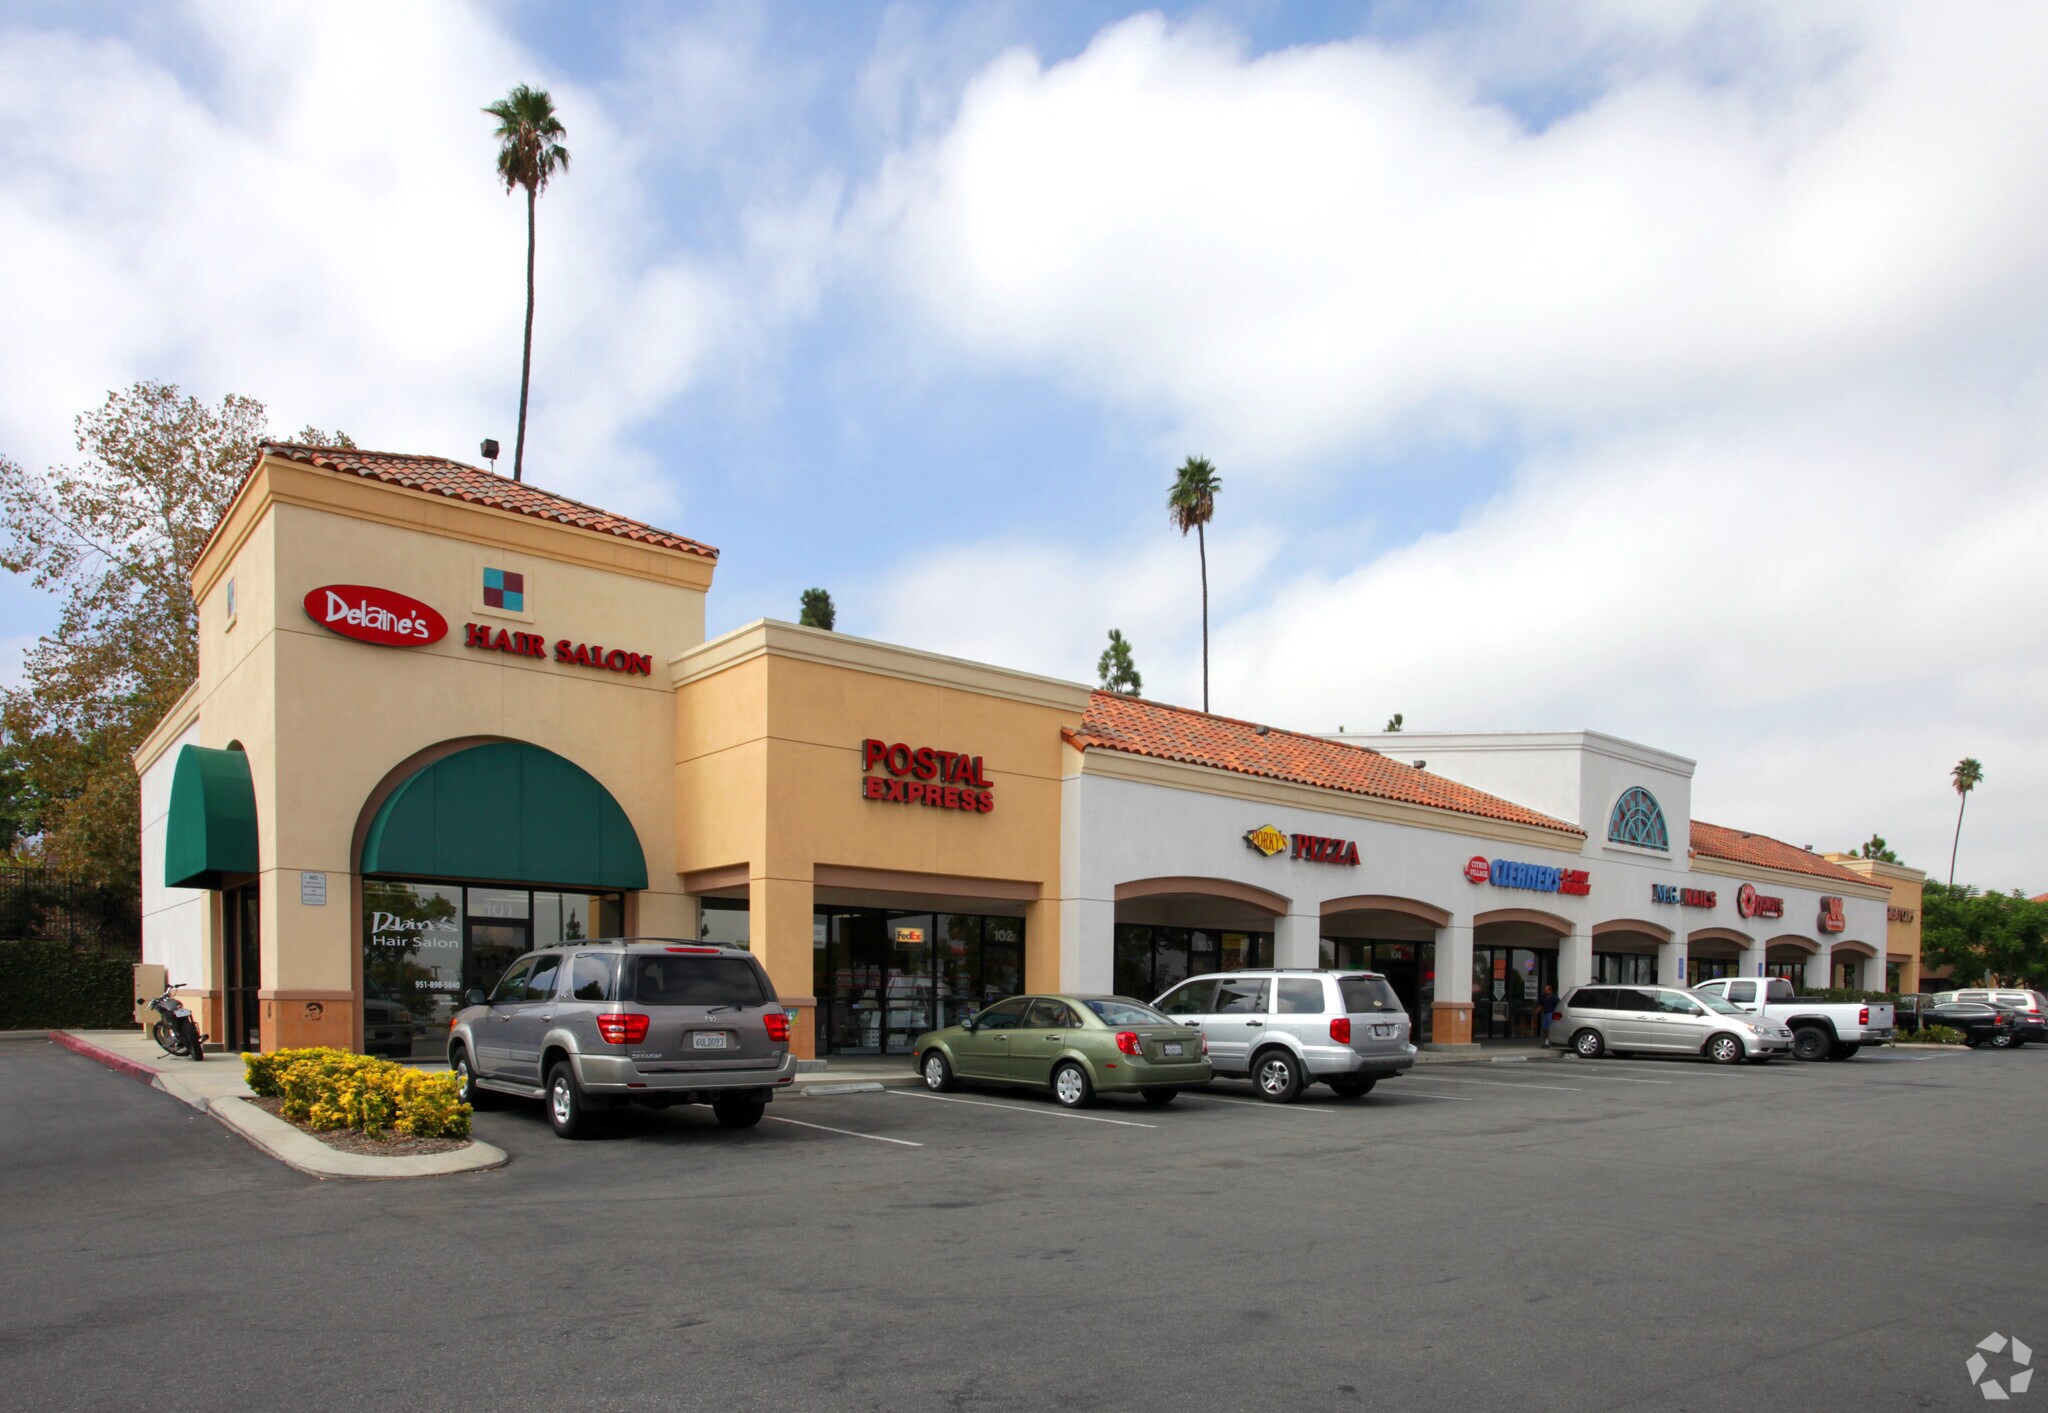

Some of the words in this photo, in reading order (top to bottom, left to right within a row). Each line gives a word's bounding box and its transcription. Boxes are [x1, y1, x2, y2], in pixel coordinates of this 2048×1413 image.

[325, 590, 429, 639] Delaine's
[464, 623, 547, 658] HAIR
[553, 639, 653, 676] SALON
[862, 738, 994, 788] POSTAL
[862, 775, 994, 813] EXPRESS
[1249, 829, 1288, 852] PORKY'S
[1290, 833, 1361, 866] PIZZA
[1469, 868, 1489, 878] VILLAGE
[1489, 858, 1562, 893] CLEANERS
[1680, 887, 1717, 909] NAILS
[1755, 894, 1784, 919] DONUTS
[372, 935, 409, 947] Hair
[412, 936, 460, 948] Salon
[897, 930, 922, 941] FedEx
[993, 929, 1014, 942] 102
